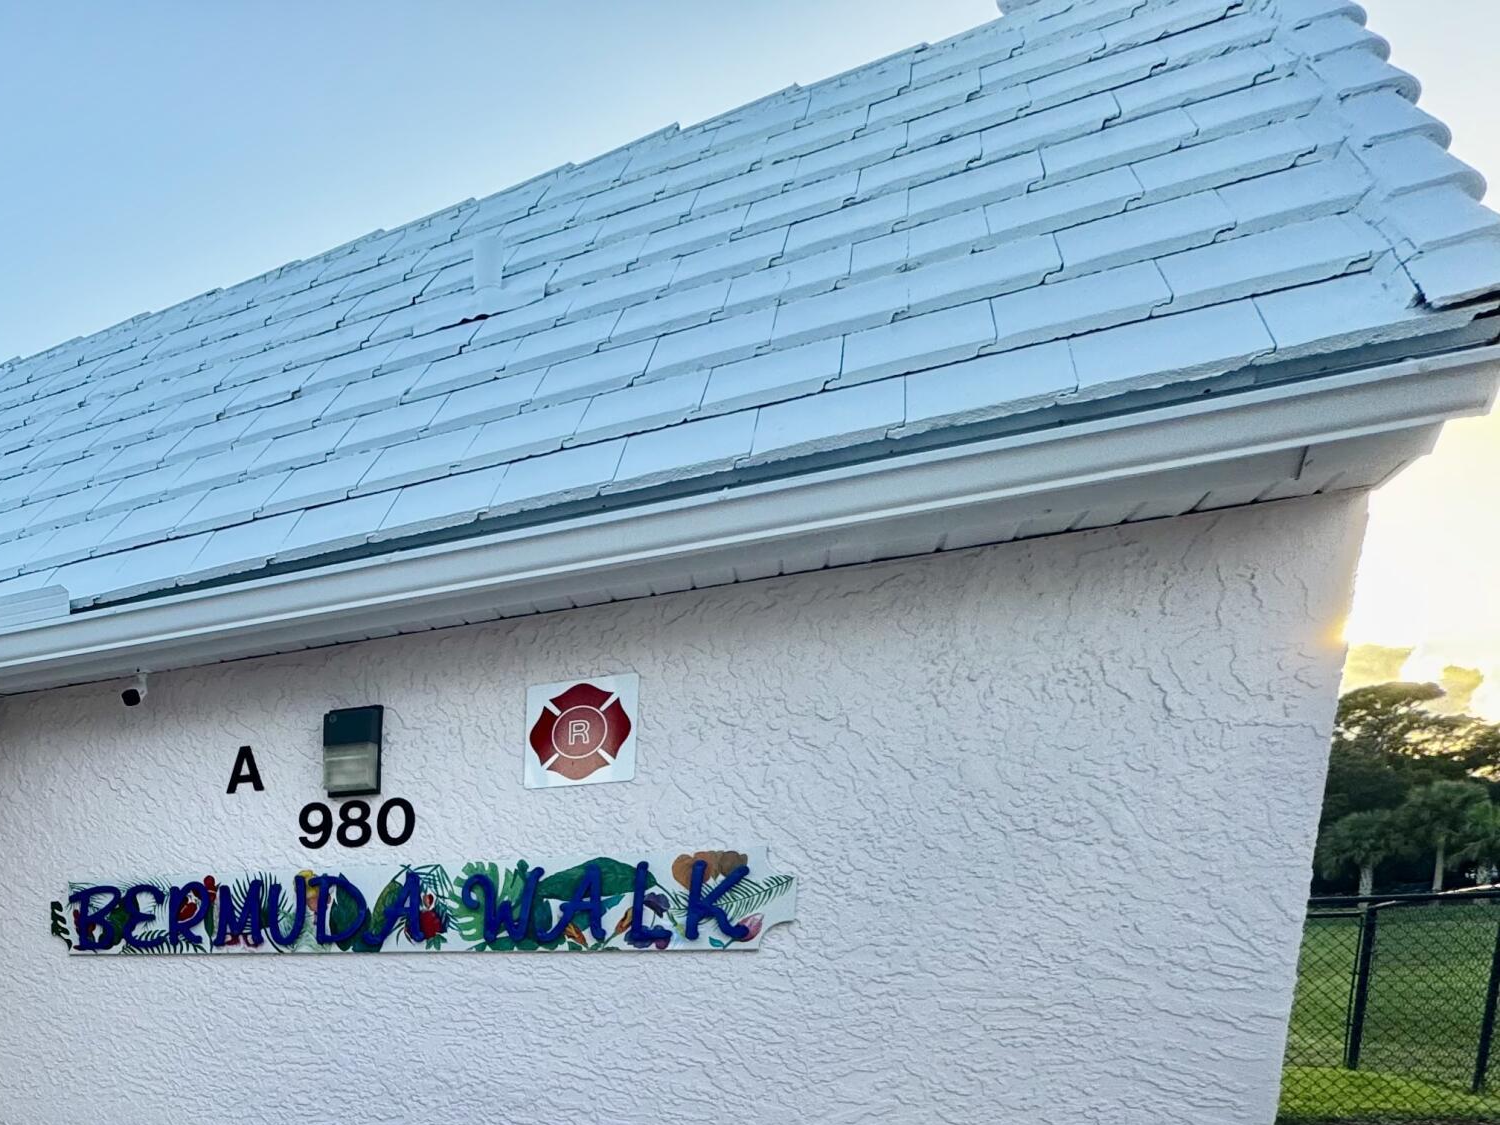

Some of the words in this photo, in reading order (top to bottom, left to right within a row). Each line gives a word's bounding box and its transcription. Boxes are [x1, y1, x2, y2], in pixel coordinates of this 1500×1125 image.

[567, 719, 591, 746] R
[226, 745, 265, 794] A
[298, 797, 416, 849] 980
[68, 869, 425, 950] BERMUDA
[462, 860, 750, 942] WALK
